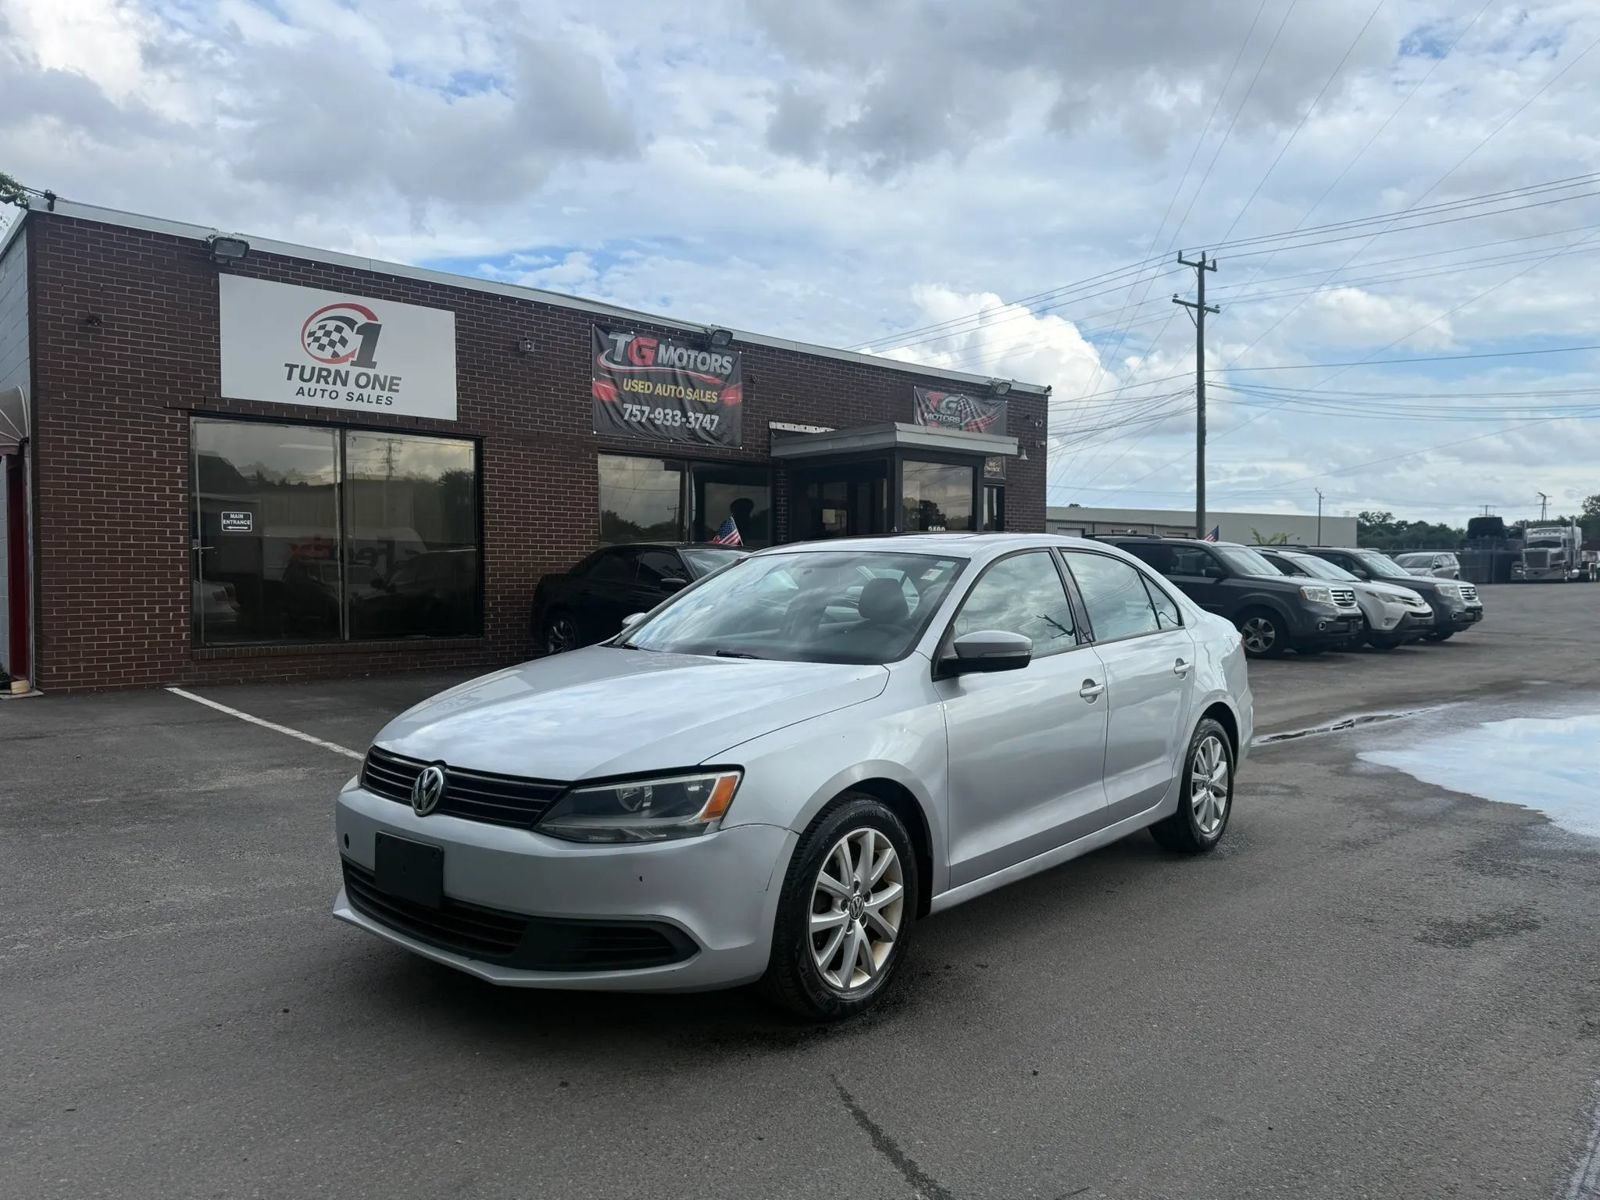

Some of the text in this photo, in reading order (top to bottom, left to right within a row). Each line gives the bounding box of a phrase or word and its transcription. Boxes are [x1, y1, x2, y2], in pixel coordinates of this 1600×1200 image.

[350, 321, 382, 369] 1
[608, 331, 733, 375] TG MOTORS
[284, 362, 402, 393] TURN ONE
[623, 378, 718, 403] USED AUTO SALES
[295, 386, 393, 405] AUTO SALES
[623, 403, 719, 431] 757-933-3747
